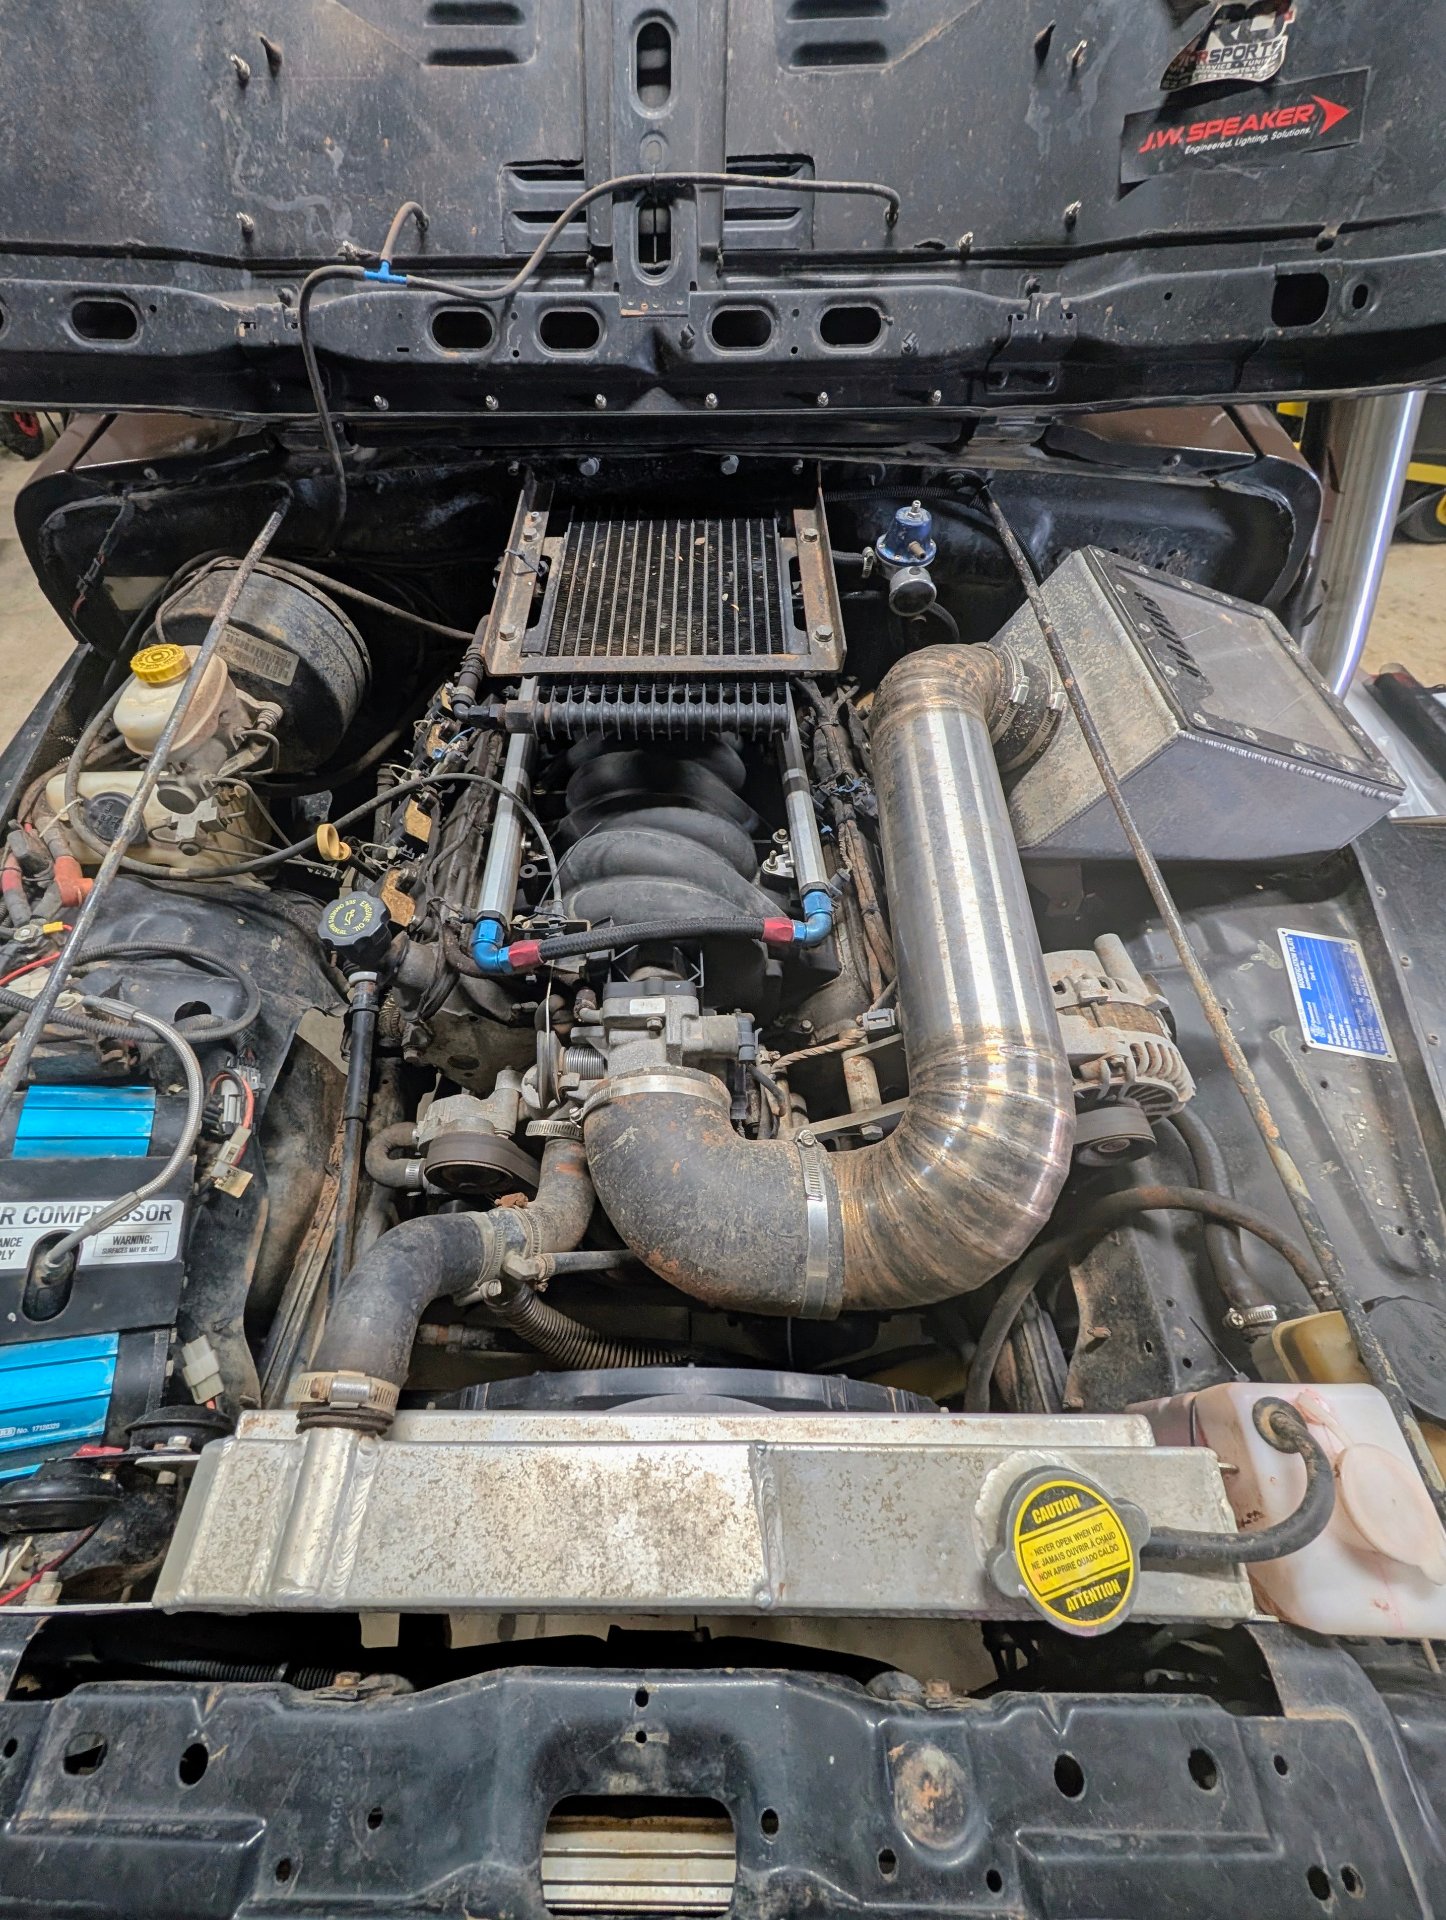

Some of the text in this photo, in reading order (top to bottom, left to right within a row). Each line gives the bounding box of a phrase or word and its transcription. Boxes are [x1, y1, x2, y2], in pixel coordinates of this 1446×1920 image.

[1184, 127, 1311, 155] Engineered. Lighting. Solutions.
[352, 900, 373, 932] ENGINE OIL
[1286, 936, 1296, 952] PLATE
[0, 1204, 173, 1225] R COMPSOR
[0, 1249, 15, 1260] LY
[112, 1235, 153, 1246] WARNING:
[1031, 1493, 1082, 1525] CAUTION
[1031, 1560, 1041, 1571] NE
[1041, 1551, 1066, 1567] JAMAIS
[1065, 1542, 1090, 1558] OUVRIR
[1095, 1531, 1117, 1546] CHAUD
[1033, 1522, 1105, 1557] NEVER OPEN WHEN HOT
[1038, 1543, 1120, 1582] NON APRIRE QUADO CALDO
[1066, 1578, 1122, 1613] ATTENTION
